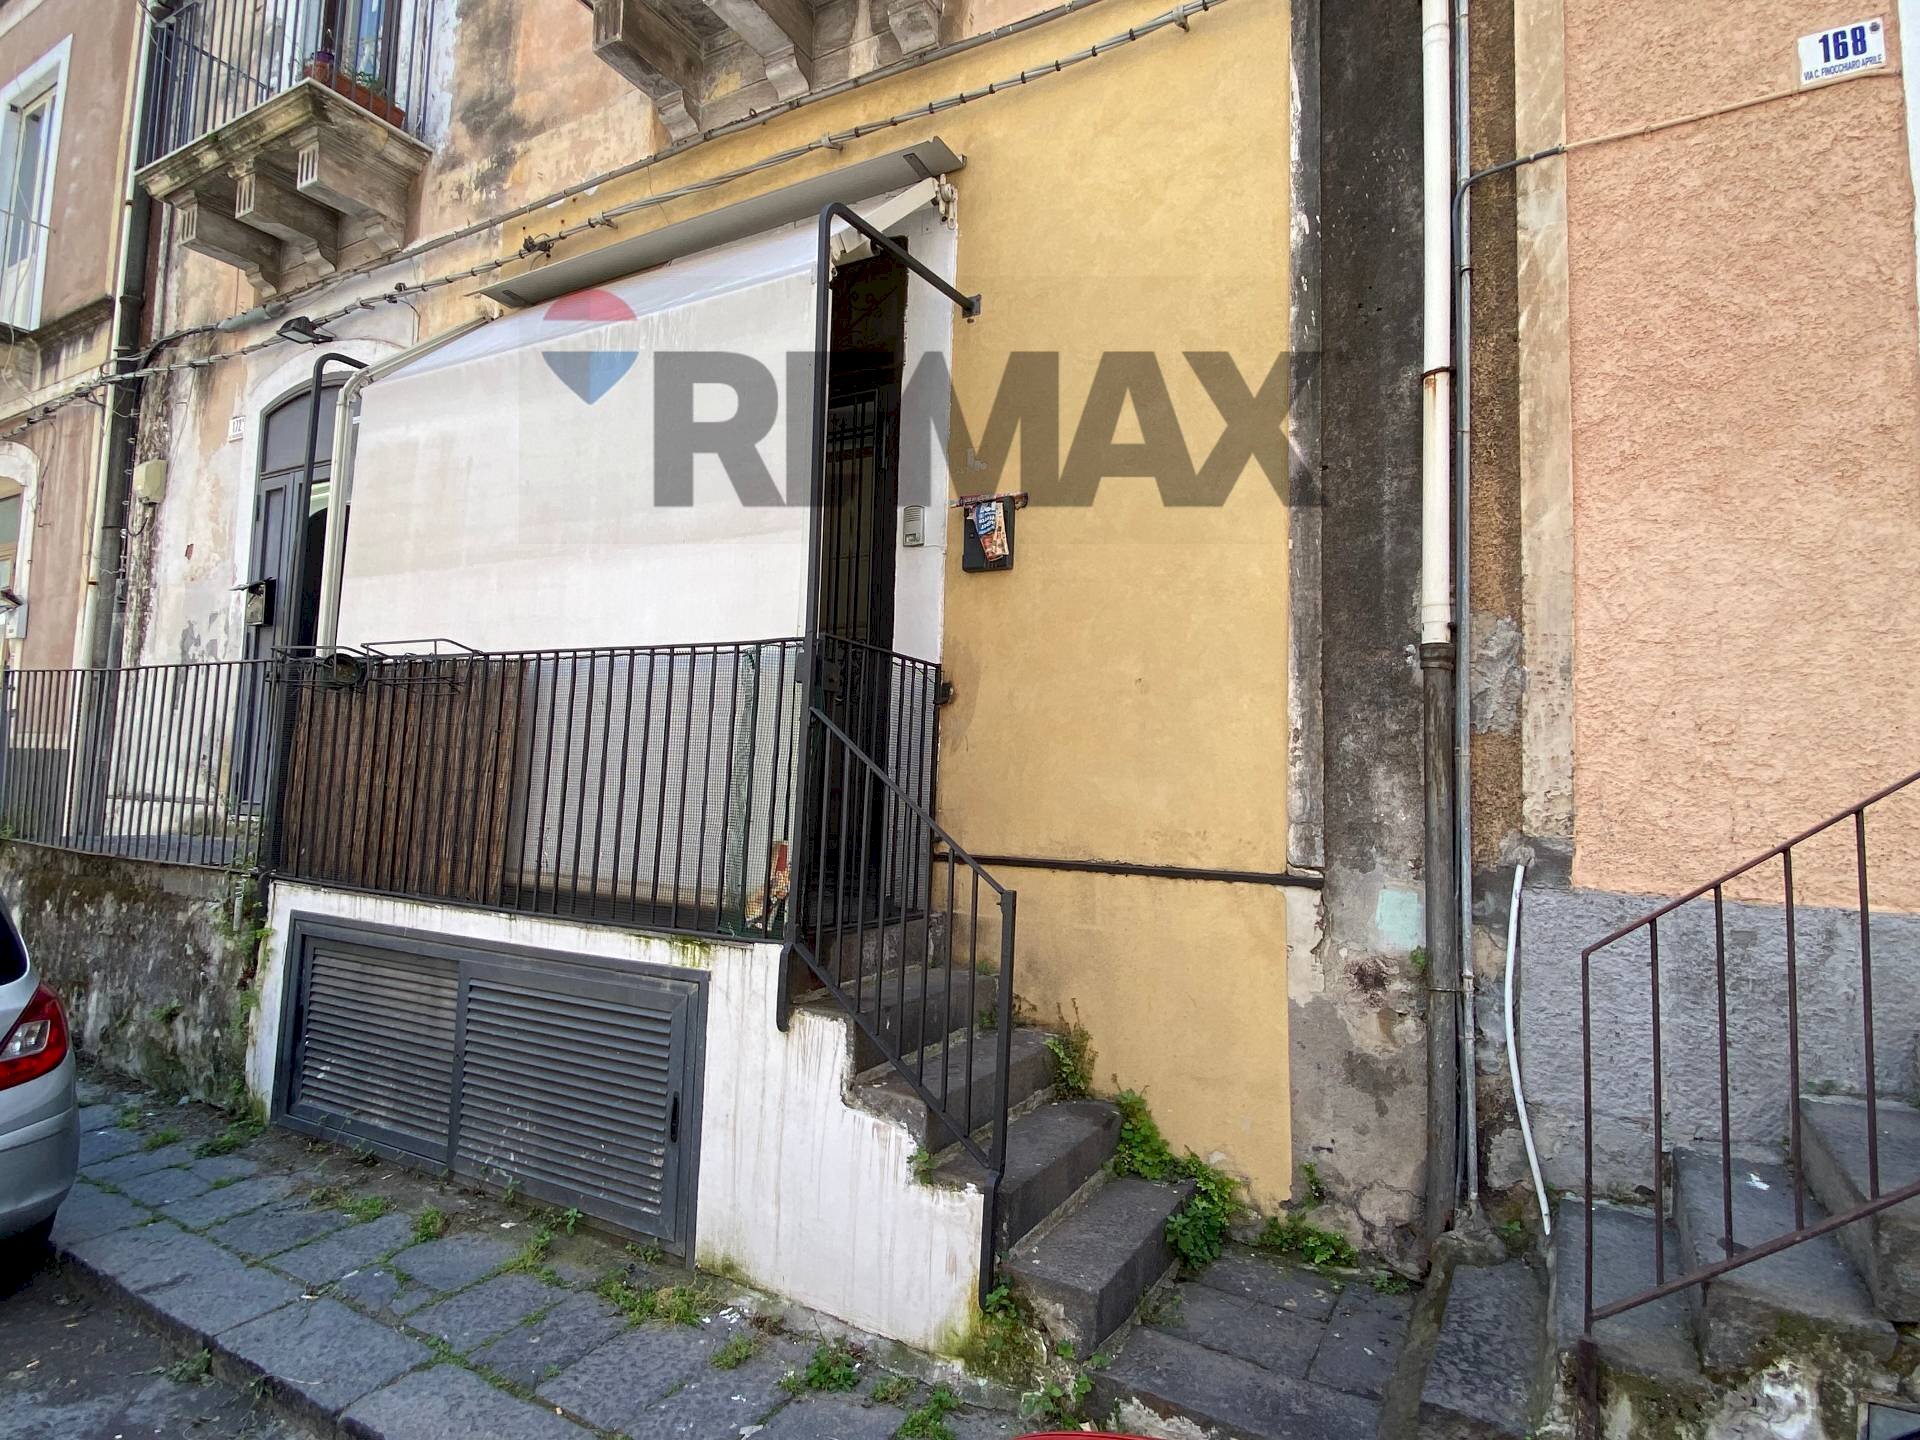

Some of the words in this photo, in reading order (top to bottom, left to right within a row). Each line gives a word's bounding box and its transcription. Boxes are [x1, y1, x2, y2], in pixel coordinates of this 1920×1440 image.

[1818, 25, 1868, 63] 168
[1803, 70, 1814, 81] VIA
[1821, 59, 1860, 76] FINOCCHIARO
[1861, 54, 1882, 67] APRILE
